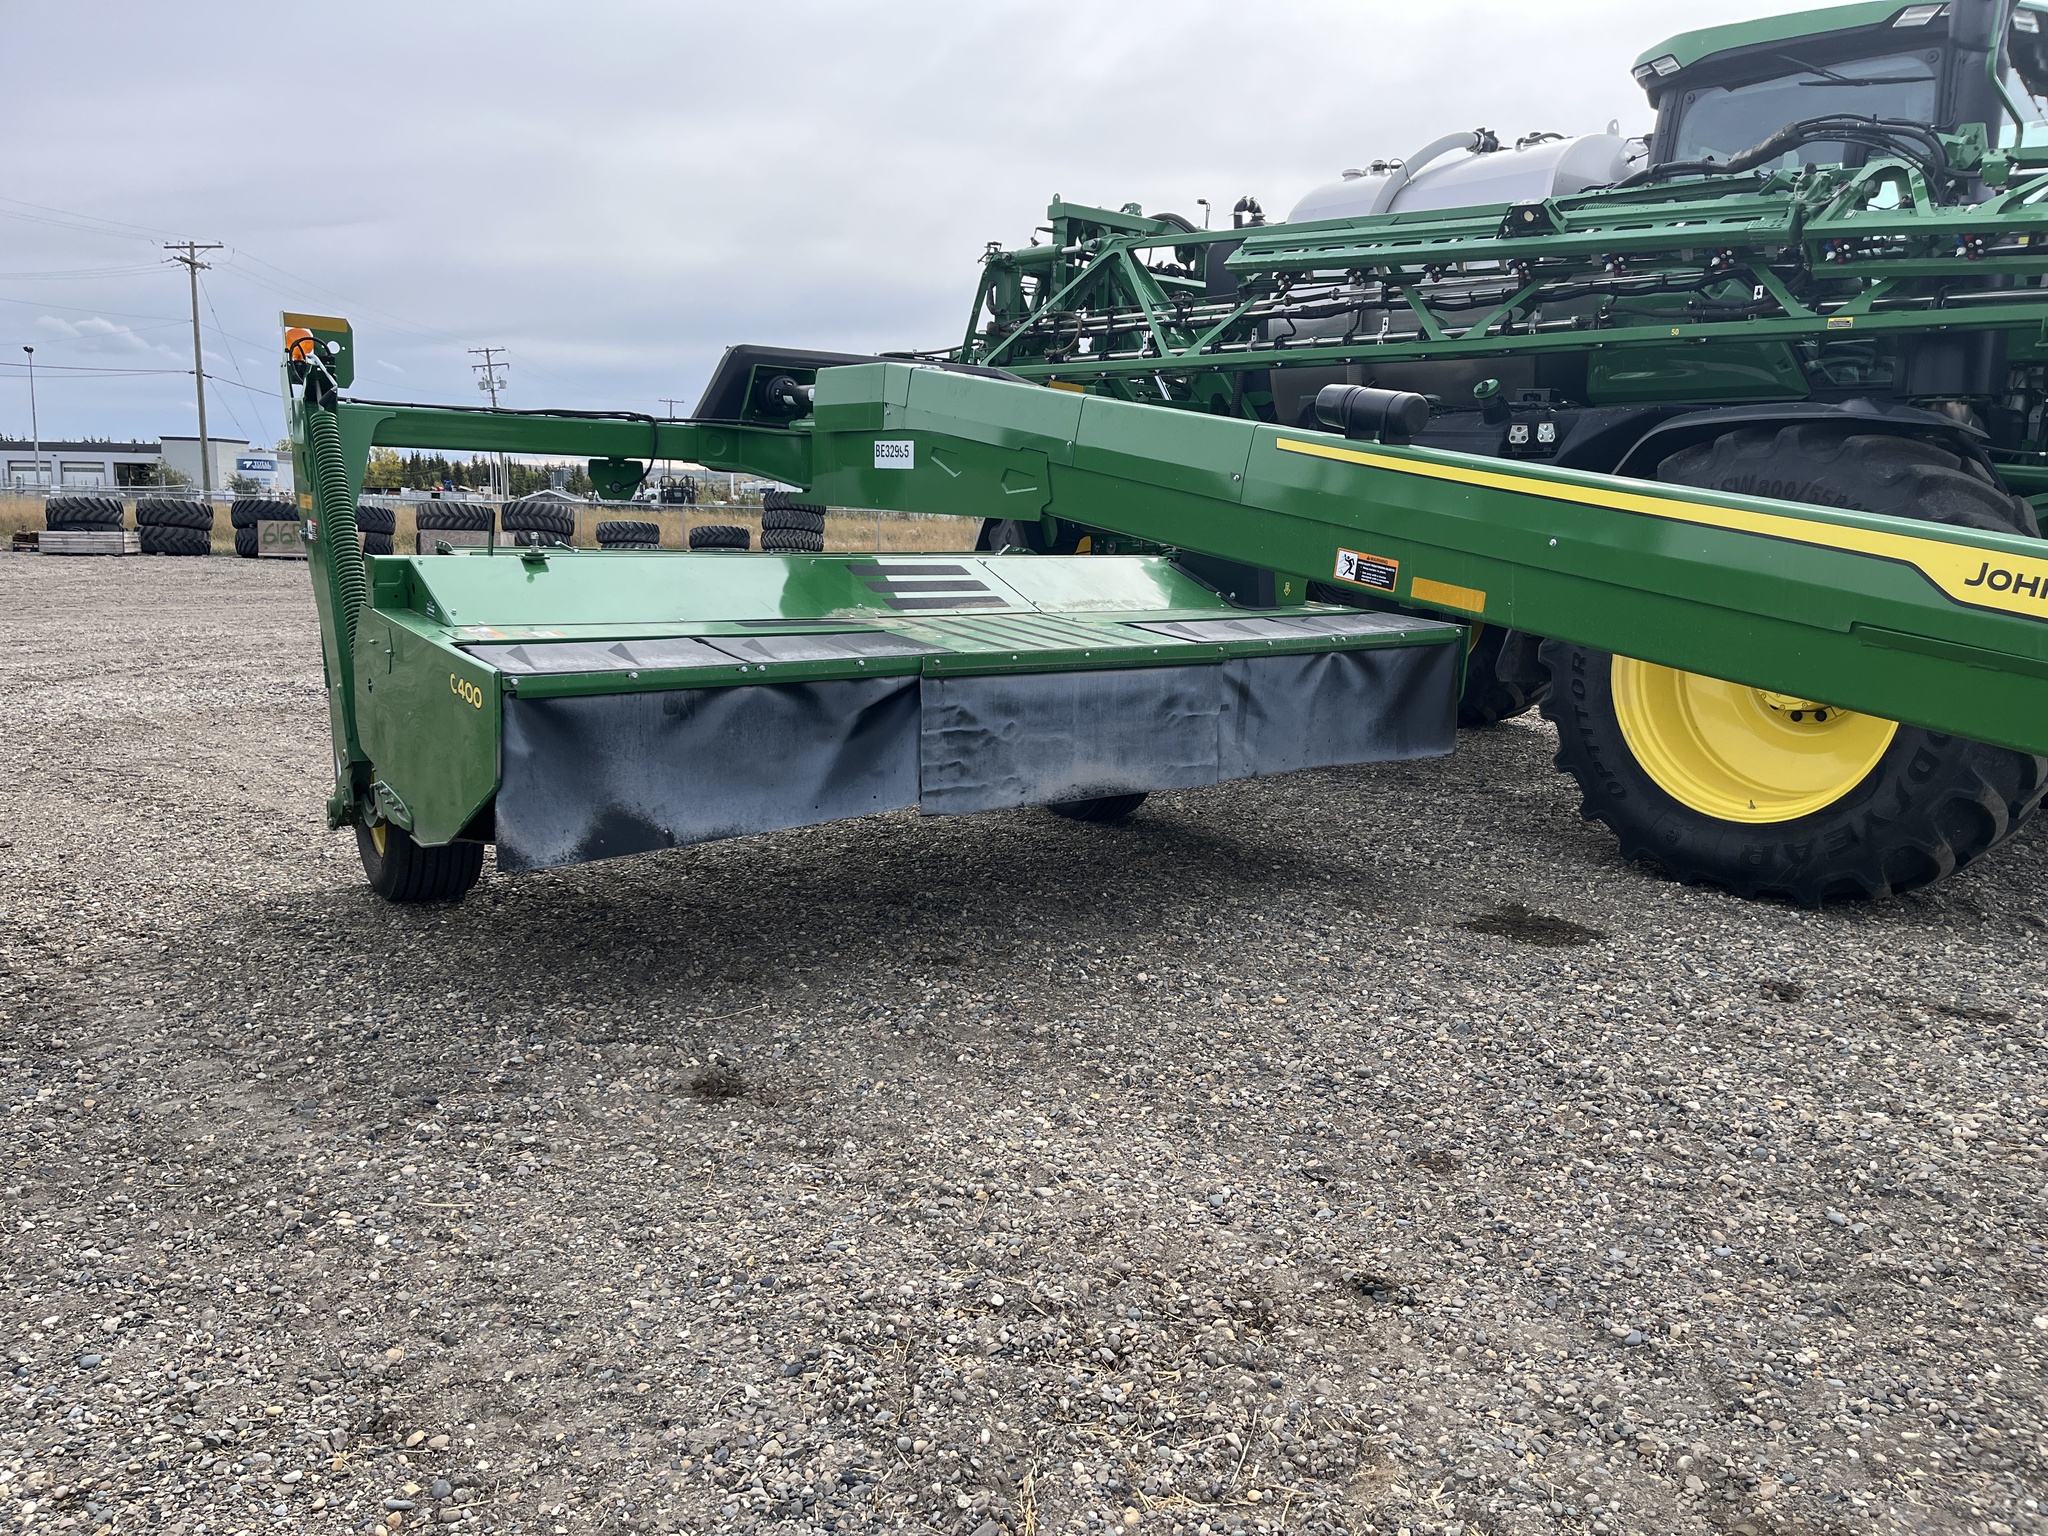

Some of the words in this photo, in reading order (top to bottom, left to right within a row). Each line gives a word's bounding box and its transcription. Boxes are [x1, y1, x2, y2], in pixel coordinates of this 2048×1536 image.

[449, 672, 482, 709] C400
[1571, 651, 1628, 799] OPTITOR
[1738, 729, 1952, 869] DYEAR
